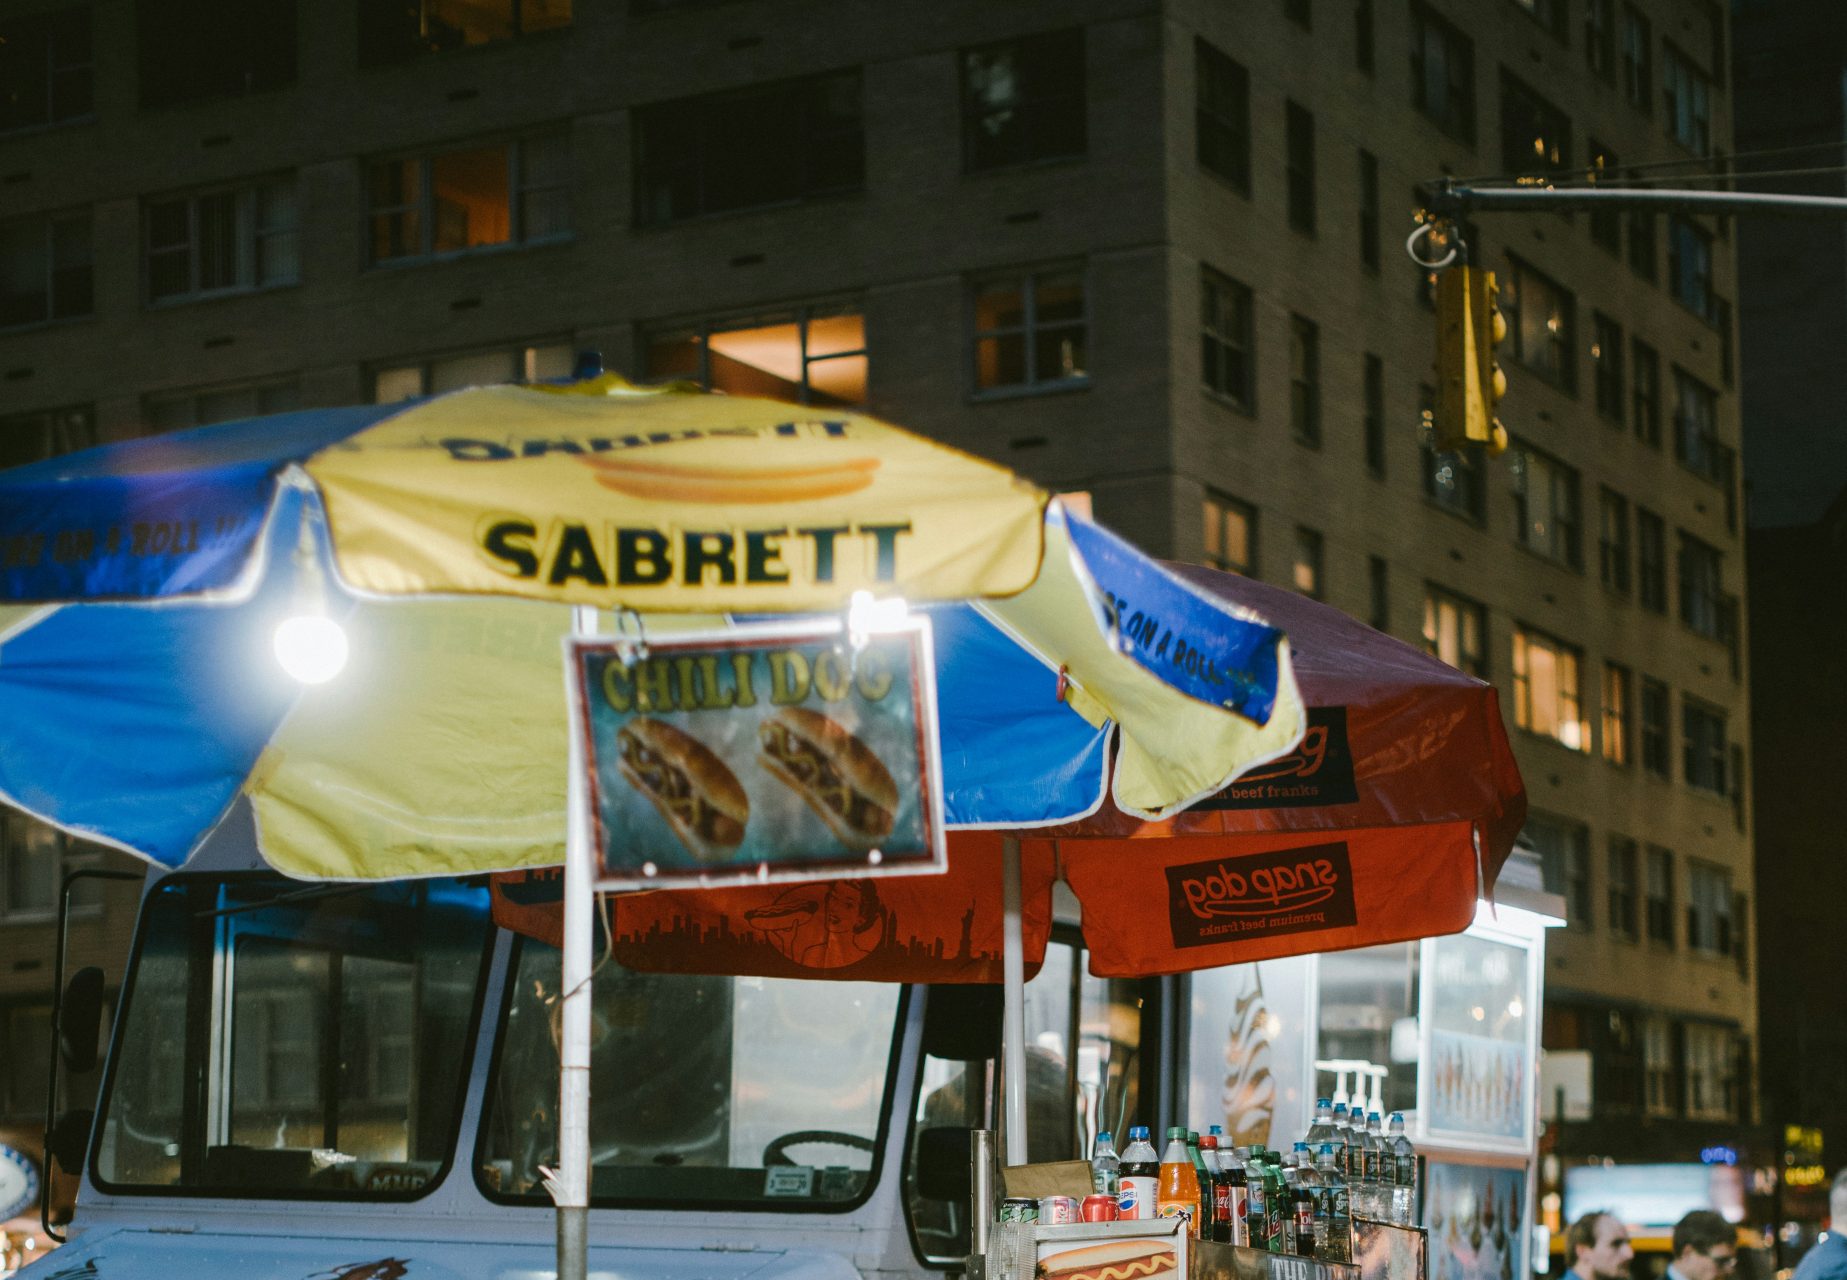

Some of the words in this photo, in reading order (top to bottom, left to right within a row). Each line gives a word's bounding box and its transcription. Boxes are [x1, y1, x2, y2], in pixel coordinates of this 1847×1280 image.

[482, 519, 912, 588] SABRETT
[602, 653, 757, 713] CHILI
[768, 650, 893, 703] DOG
[1126, 611, 1159, 651] ON
[1155, 629, 1173, 660] A
[1173, 638, 1224, 686] ROLL
[1232, 786, 1264, 799] beef
[1267, 784, 1319, 797] franks
